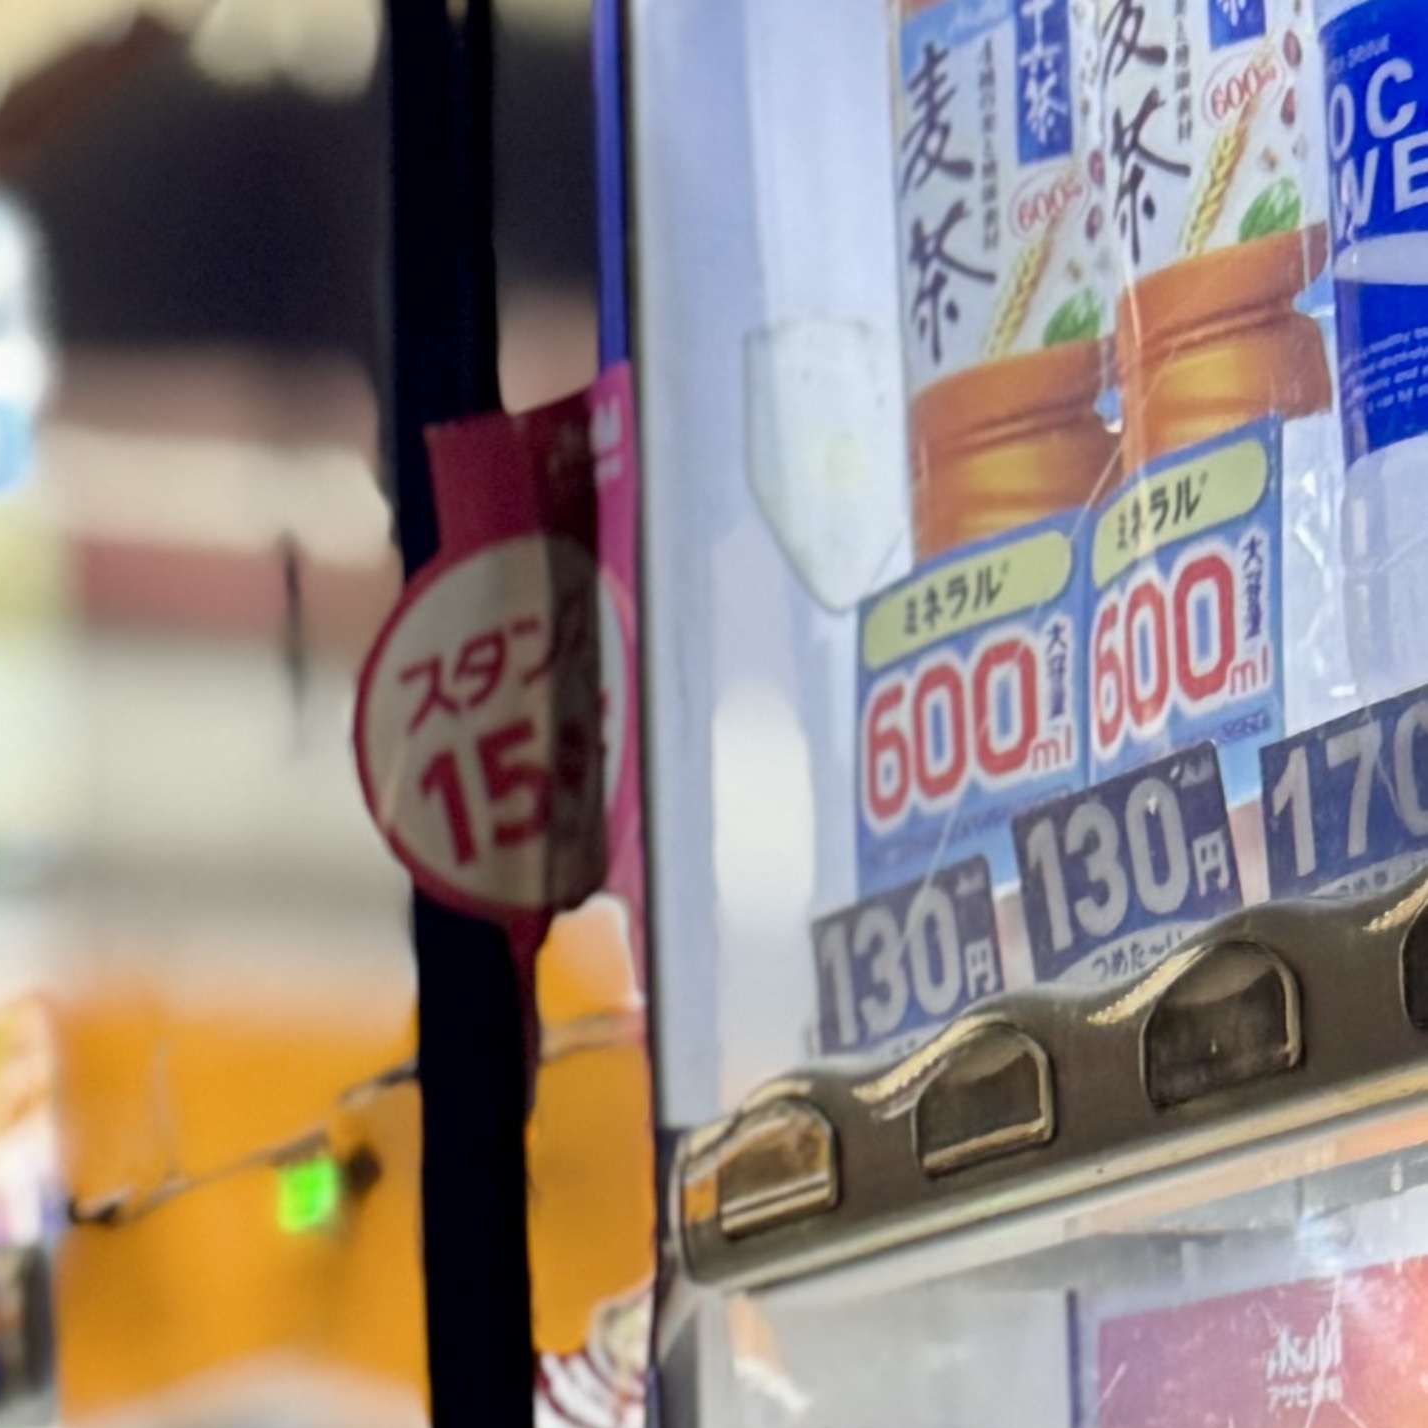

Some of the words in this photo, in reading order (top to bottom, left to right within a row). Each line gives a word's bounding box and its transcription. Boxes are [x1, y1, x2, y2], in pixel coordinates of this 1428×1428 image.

[900, 40, 996, 363] 麦茶
[903, 563, 1004, 635] ミネラル
